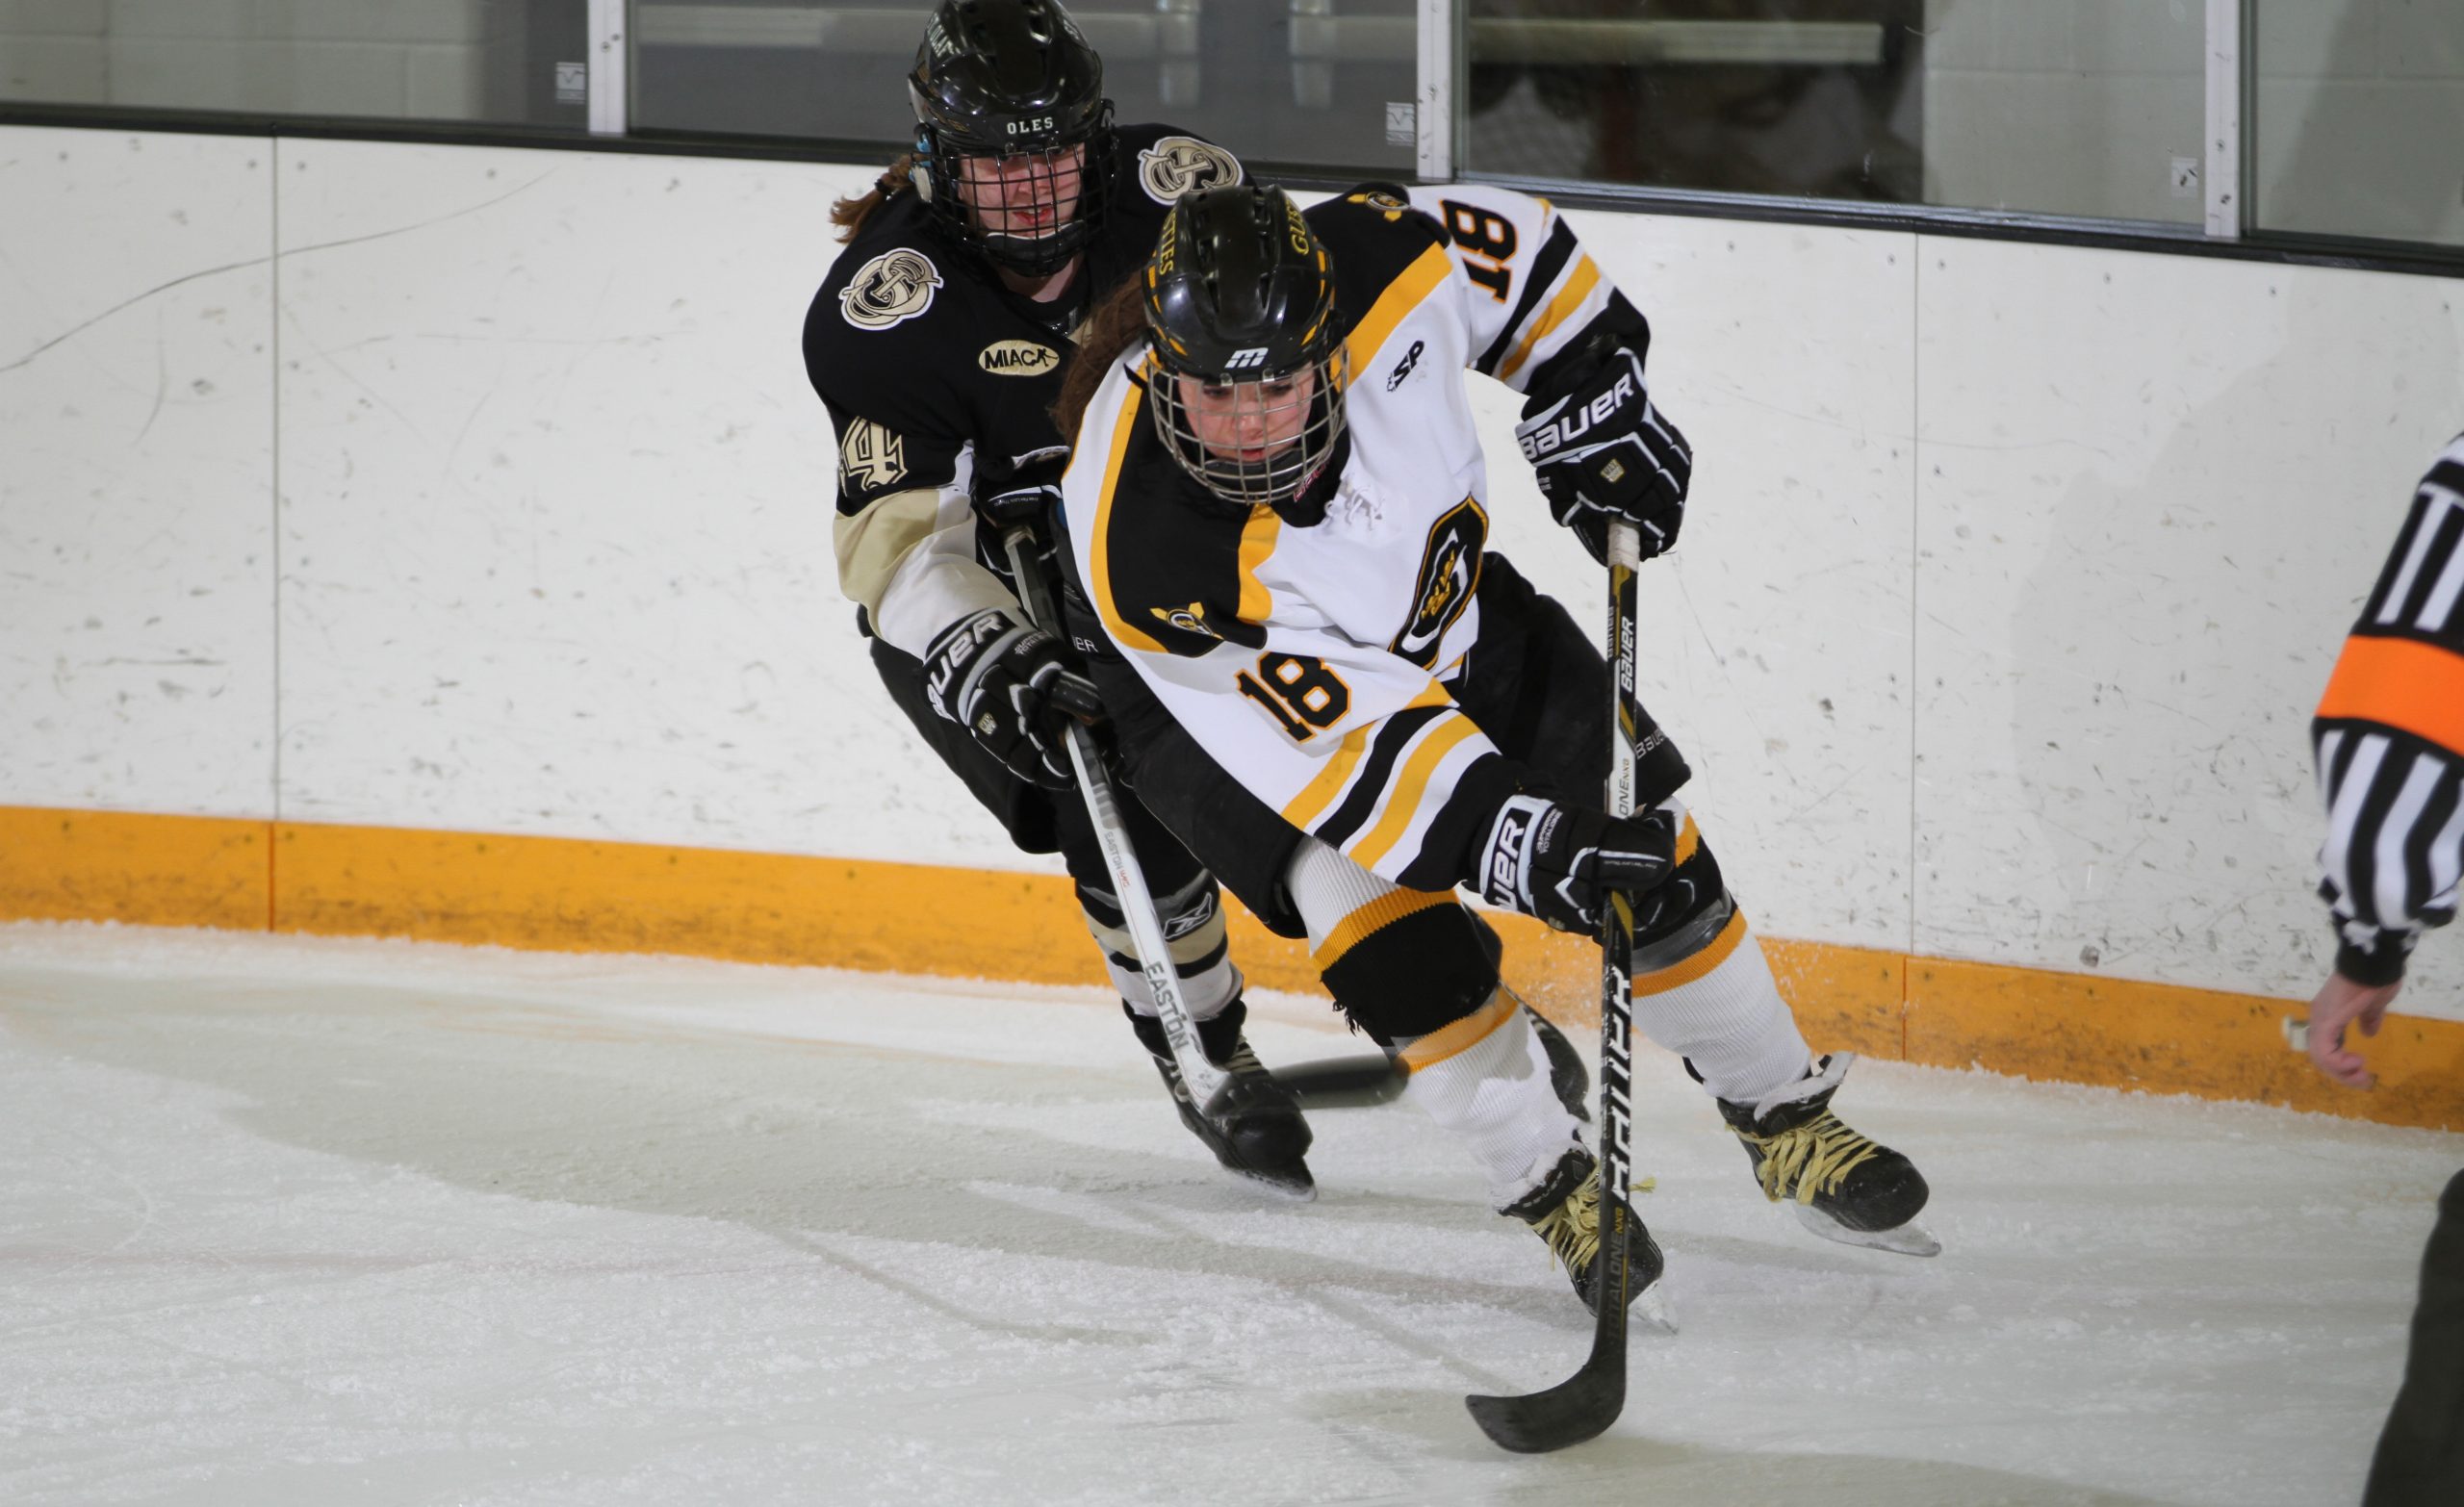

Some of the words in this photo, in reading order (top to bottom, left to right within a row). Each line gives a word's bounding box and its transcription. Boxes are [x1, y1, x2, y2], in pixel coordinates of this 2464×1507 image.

[1007, 116, 1054, 135] OLES
[1439, 198, 1518, 304] 18
[1393, 340, 1424, 389] SP
[839, 415, 908, 497] 4
[1518, 372, 1633, 460] BAUER
[1621, 616, 1633, 693] BAUER
[1233, 651, 1351, 745] 18
[1145, 961, 1189, 1051] EASTON
